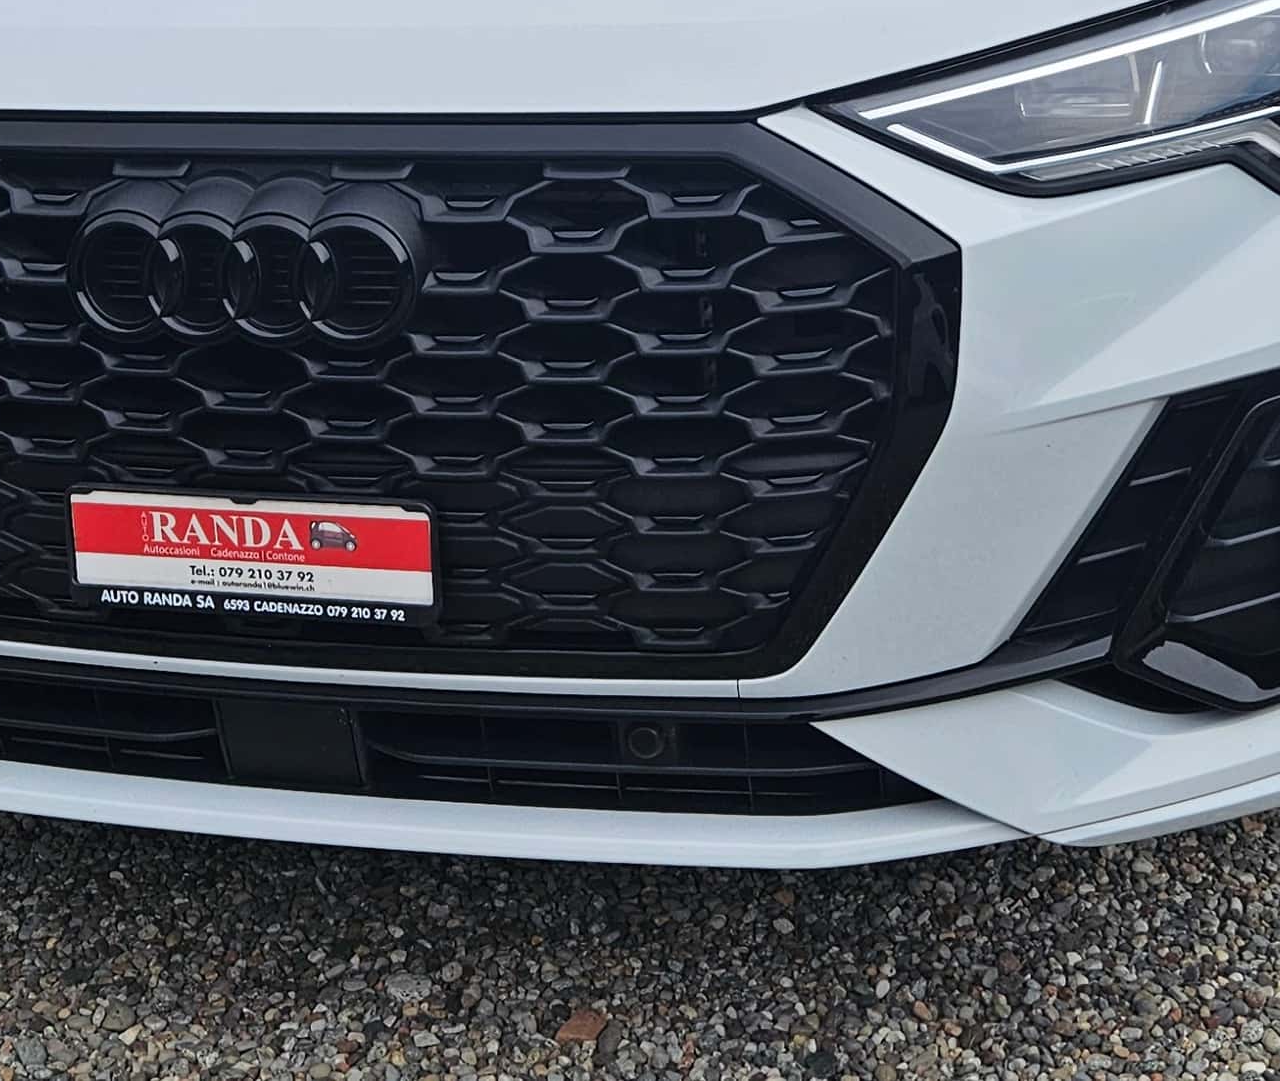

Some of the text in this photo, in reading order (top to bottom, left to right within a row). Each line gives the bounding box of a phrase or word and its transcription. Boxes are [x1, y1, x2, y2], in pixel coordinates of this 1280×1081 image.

[141, 511, 150, 542] AUTO
[149, 511, 305, 550] RANDA
[144, 545, 305, 562] Autoccasioni Cadenazzo Contone
[189, 565, 314, 583] Tel.: 079 210 37 92
[190, 578, 215, 587] e-mail
[101, 589, 405, 621] AUTO RANDA SA 6593 CADENAZZO 079 210 37 92
